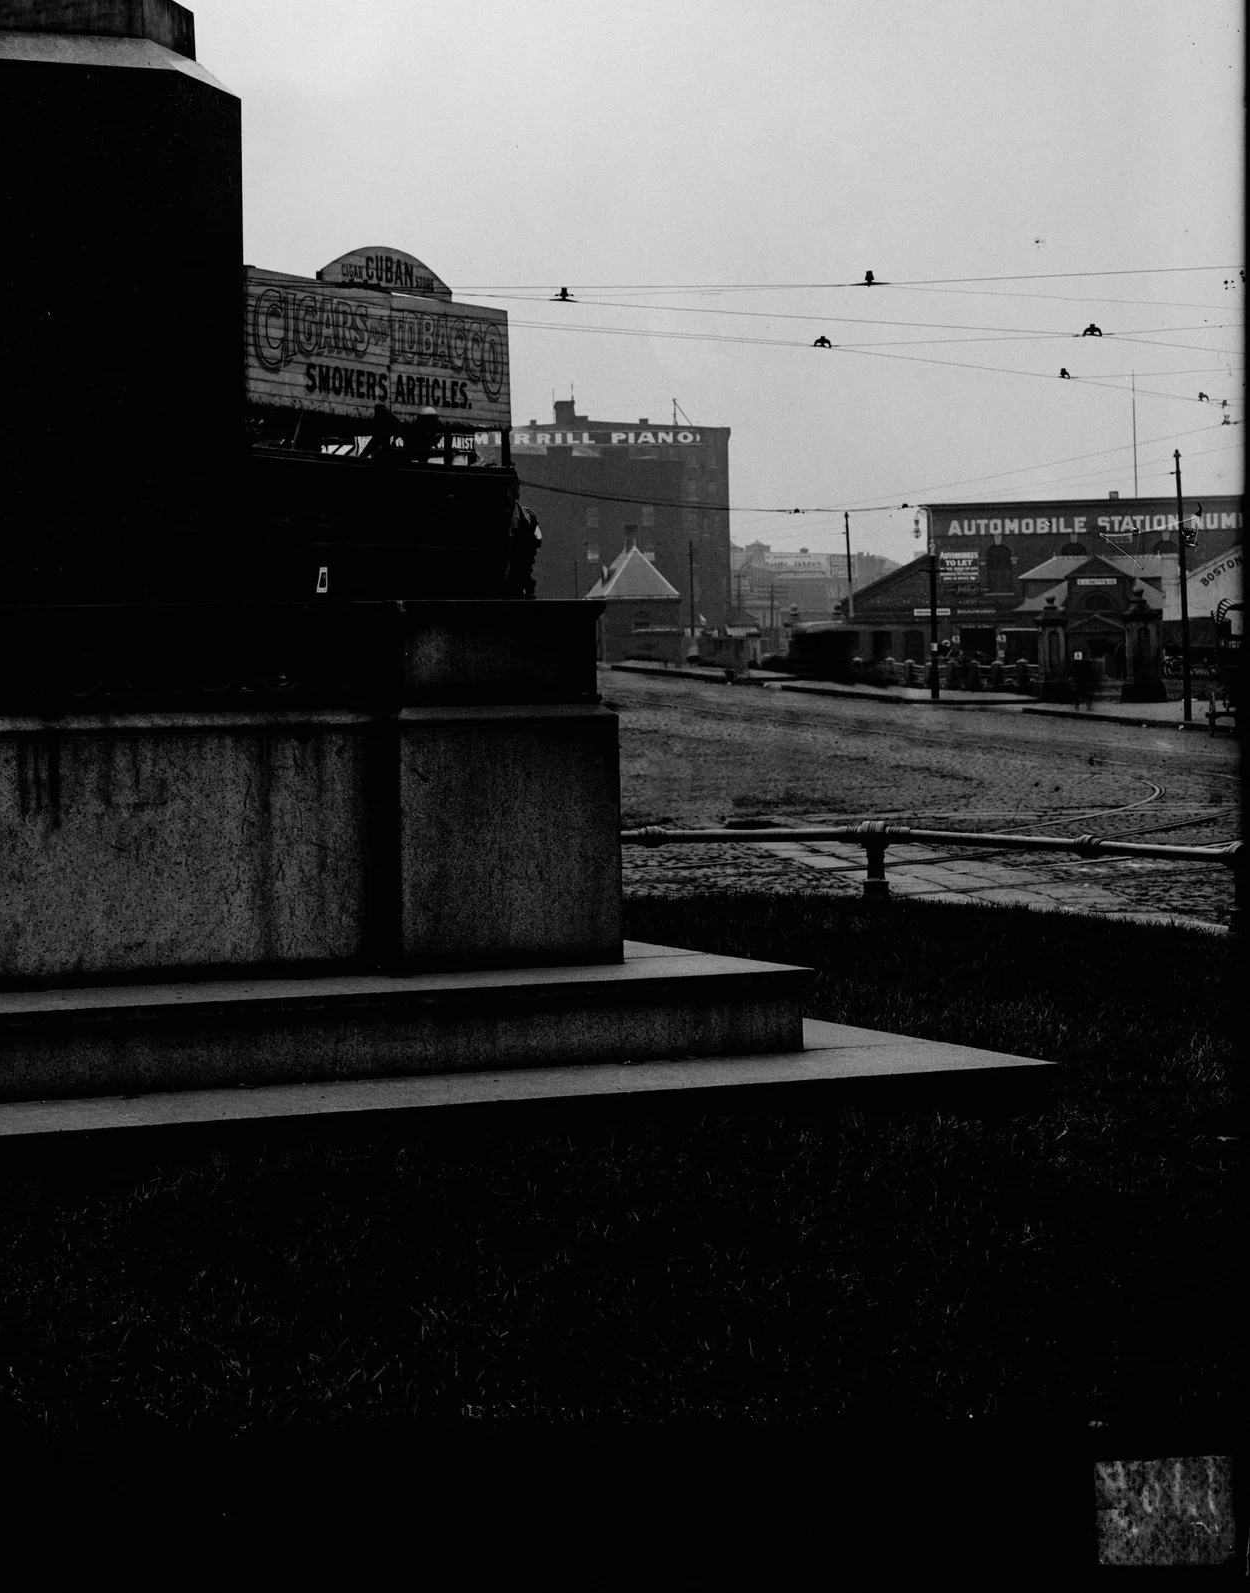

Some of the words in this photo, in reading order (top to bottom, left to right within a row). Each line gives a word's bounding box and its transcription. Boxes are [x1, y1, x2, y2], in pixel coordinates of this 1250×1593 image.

[365, 255, 414, 287] CUBAN
[254, 288, 370, 371] CIGARS
[390, 310, 503, 402] TOBACCO
[947, 516, 1088, 536] AUTOMOBILE
[1097, 515, 1179, 532] STATION
[1200, 555, 1244, 587] BOSTON
